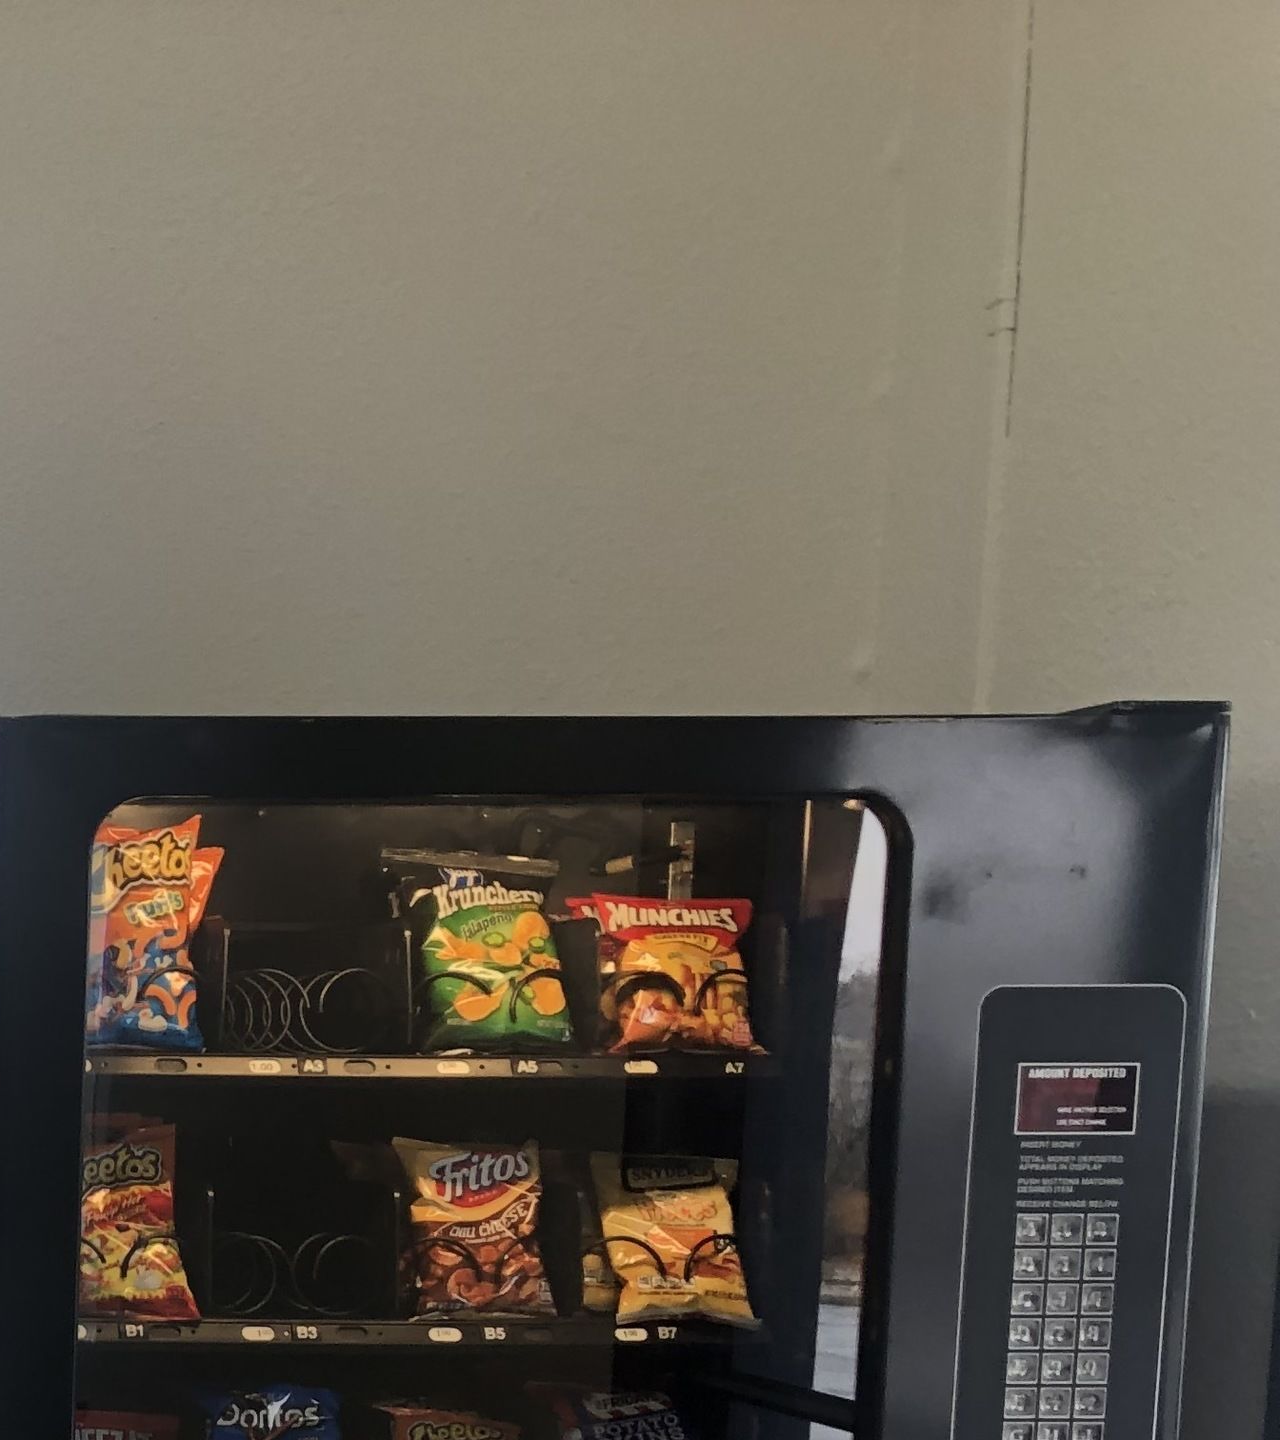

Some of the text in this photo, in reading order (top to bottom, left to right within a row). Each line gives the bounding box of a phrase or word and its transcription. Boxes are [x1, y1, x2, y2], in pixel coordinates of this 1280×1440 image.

[605, 901, 738, 932] MUNCHIES
[303, 1060, 324, 1072] A3
[517, 1061, 538, 1074] A5
[725, 1061, 744, 1074] A7
[1028, 1068, 1126, 1078] AMOUNT DEPOSITED
[83, 1146, 161, 1182] eetos
[429, 1151, 529, 1203] Fritos
[449, 1225, 476, 1238] CHILI
[125, 1324, 144, 1338] B1
[297, 1326, 318, 1340] B3
[484, 1327, 506, 1340] B5
[658, 1327, 678, 1340] B7
[216, 1393, 321, 1430] Doritos
[593, 1411, 679, 1439] POTATO
